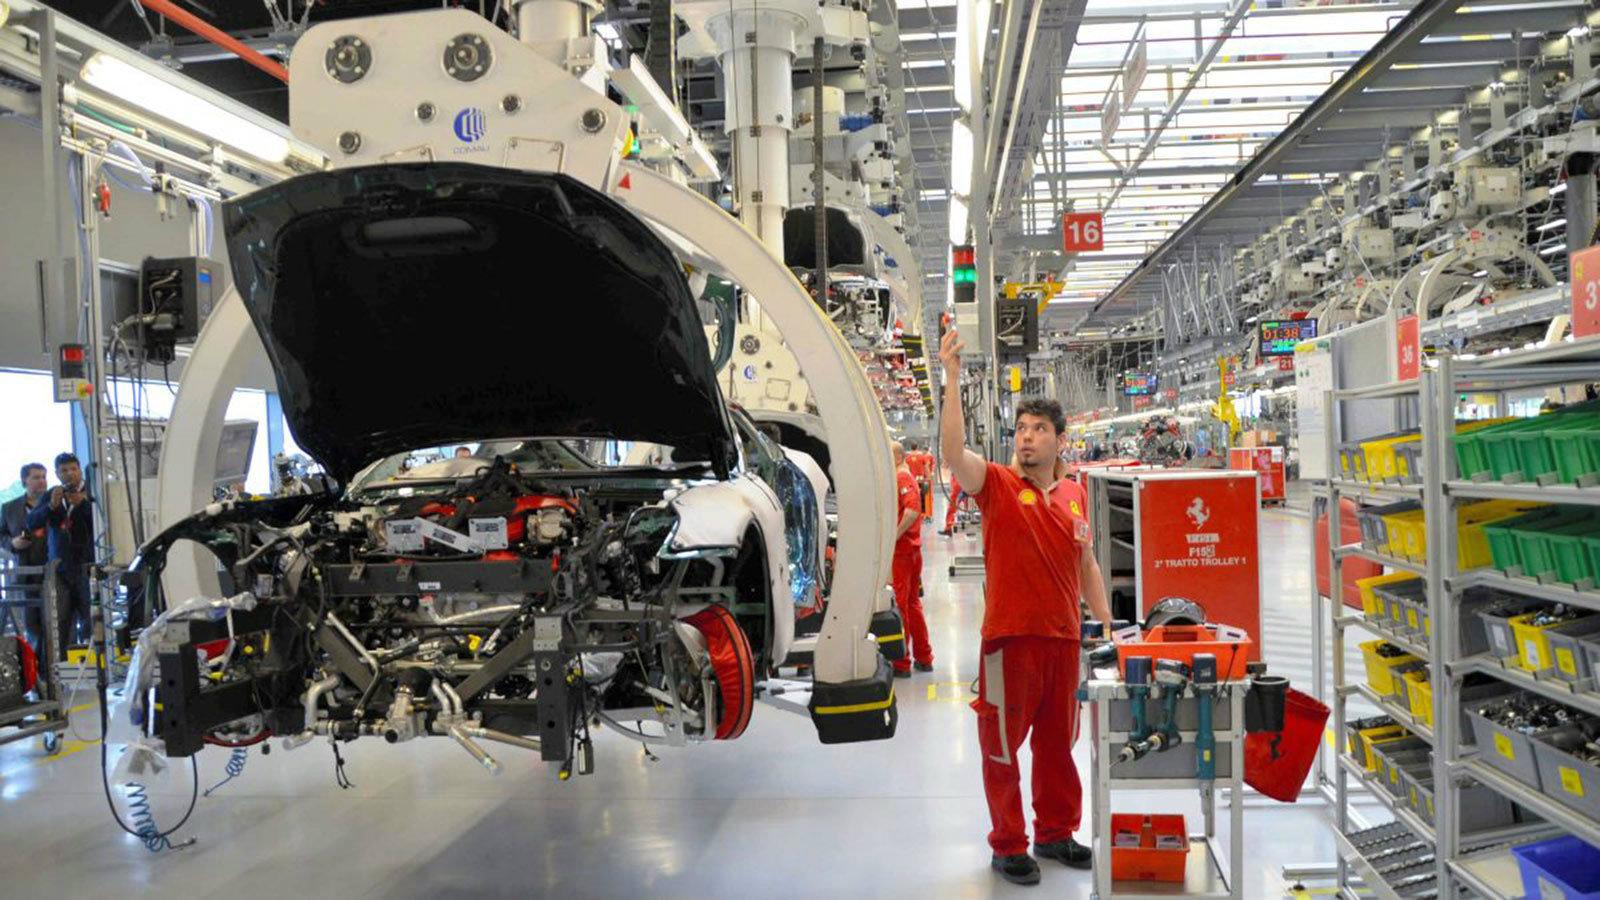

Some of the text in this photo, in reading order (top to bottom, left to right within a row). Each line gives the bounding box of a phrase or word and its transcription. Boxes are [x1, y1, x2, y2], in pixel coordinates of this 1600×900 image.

[1069, 220, 1100, 244] 16
[1586, 278, 1600, 310] 3
[1166, 558, 1198, 568] TRATTO
[1201, 556, 1239, 567] TROLLEY
[1241, 557, 1247, 565] 1
